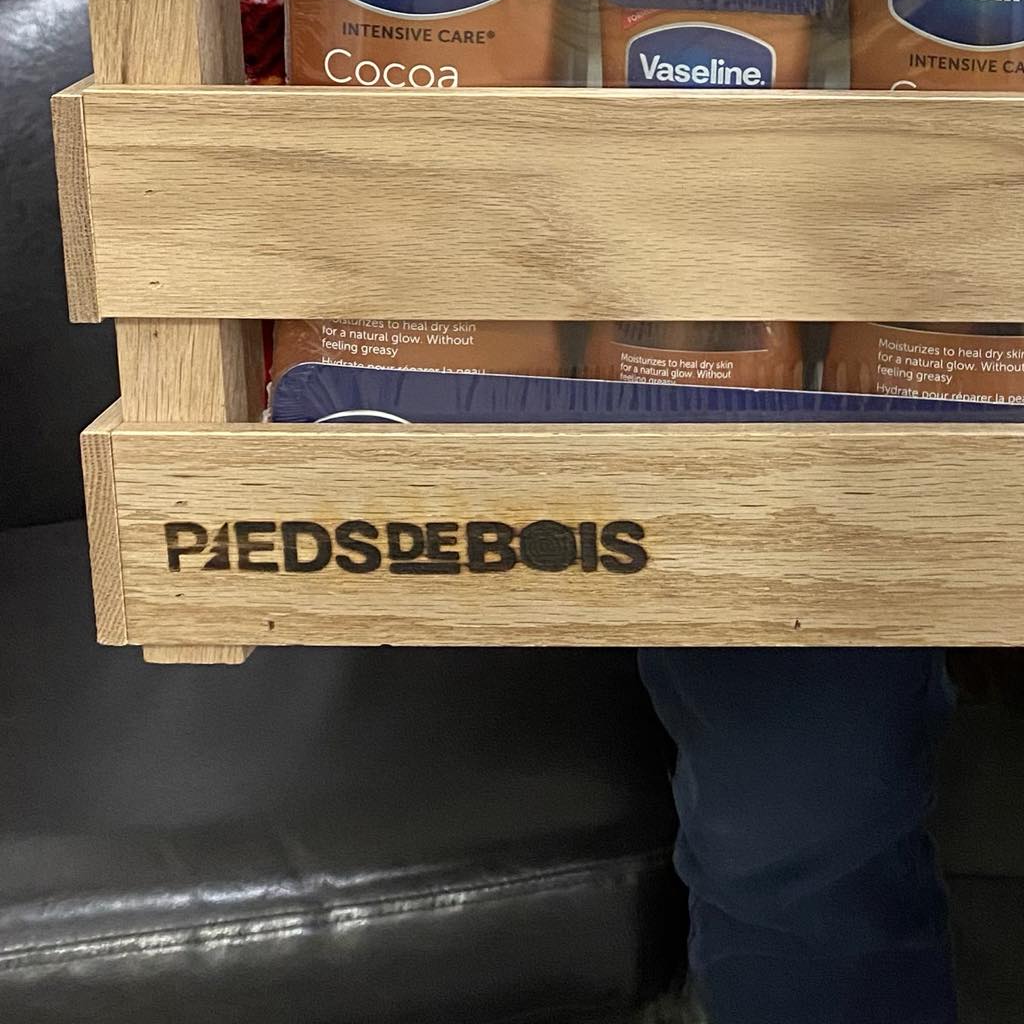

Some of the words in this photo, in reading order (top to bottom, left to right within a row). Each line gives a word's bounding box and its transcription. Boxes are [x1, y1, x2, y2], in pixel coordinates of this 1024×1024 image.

[342, 21, 432, 42] INTENSIVE
[324, 48, 459, 88] Cocoa
[908, 53, 998, 73] INTENSIVE
[321, 325, 337, 336] for
[339, 329, 346, 338] a
[349, 330, 389, 343] natural
[426, 334, 475, 346] Without
[402, 320, 428, 331] heal
[430, 321, 450, 334] dry
[452, 321, 477, 333] skin
[321, 338, 358, 354] feeling
[360, 346, 399, 358] greasy
[878, 338, 940, 356] Moisturizes
[943, 347, 955, 357] to
[957, 347, 982, 359] heal
[985, 349, 1004, 361] dry
[620, 352, 667, 367] Moisturizes
[668, 360, 678, 368] to
[679, 360, 698, 369] heal
[699, 360, 715, 371] dry
[716, 361, 734, 370] skin
[877, 351, 893, 362] for
[895, 356, 902, 365] a
[904, 357, 944, 369] natural
[620, 363, 632, 372] for
[640, 366, 670, 377] natural
[697, 370, 732, 380] Without
[876, 364, 914, 380] feeling
[916, 371, 953, 385] greasy
[876, 382, 919, 398] Hydrate
[921, 390, 949, 400] pour
[995, 392, 1005, 403] la
